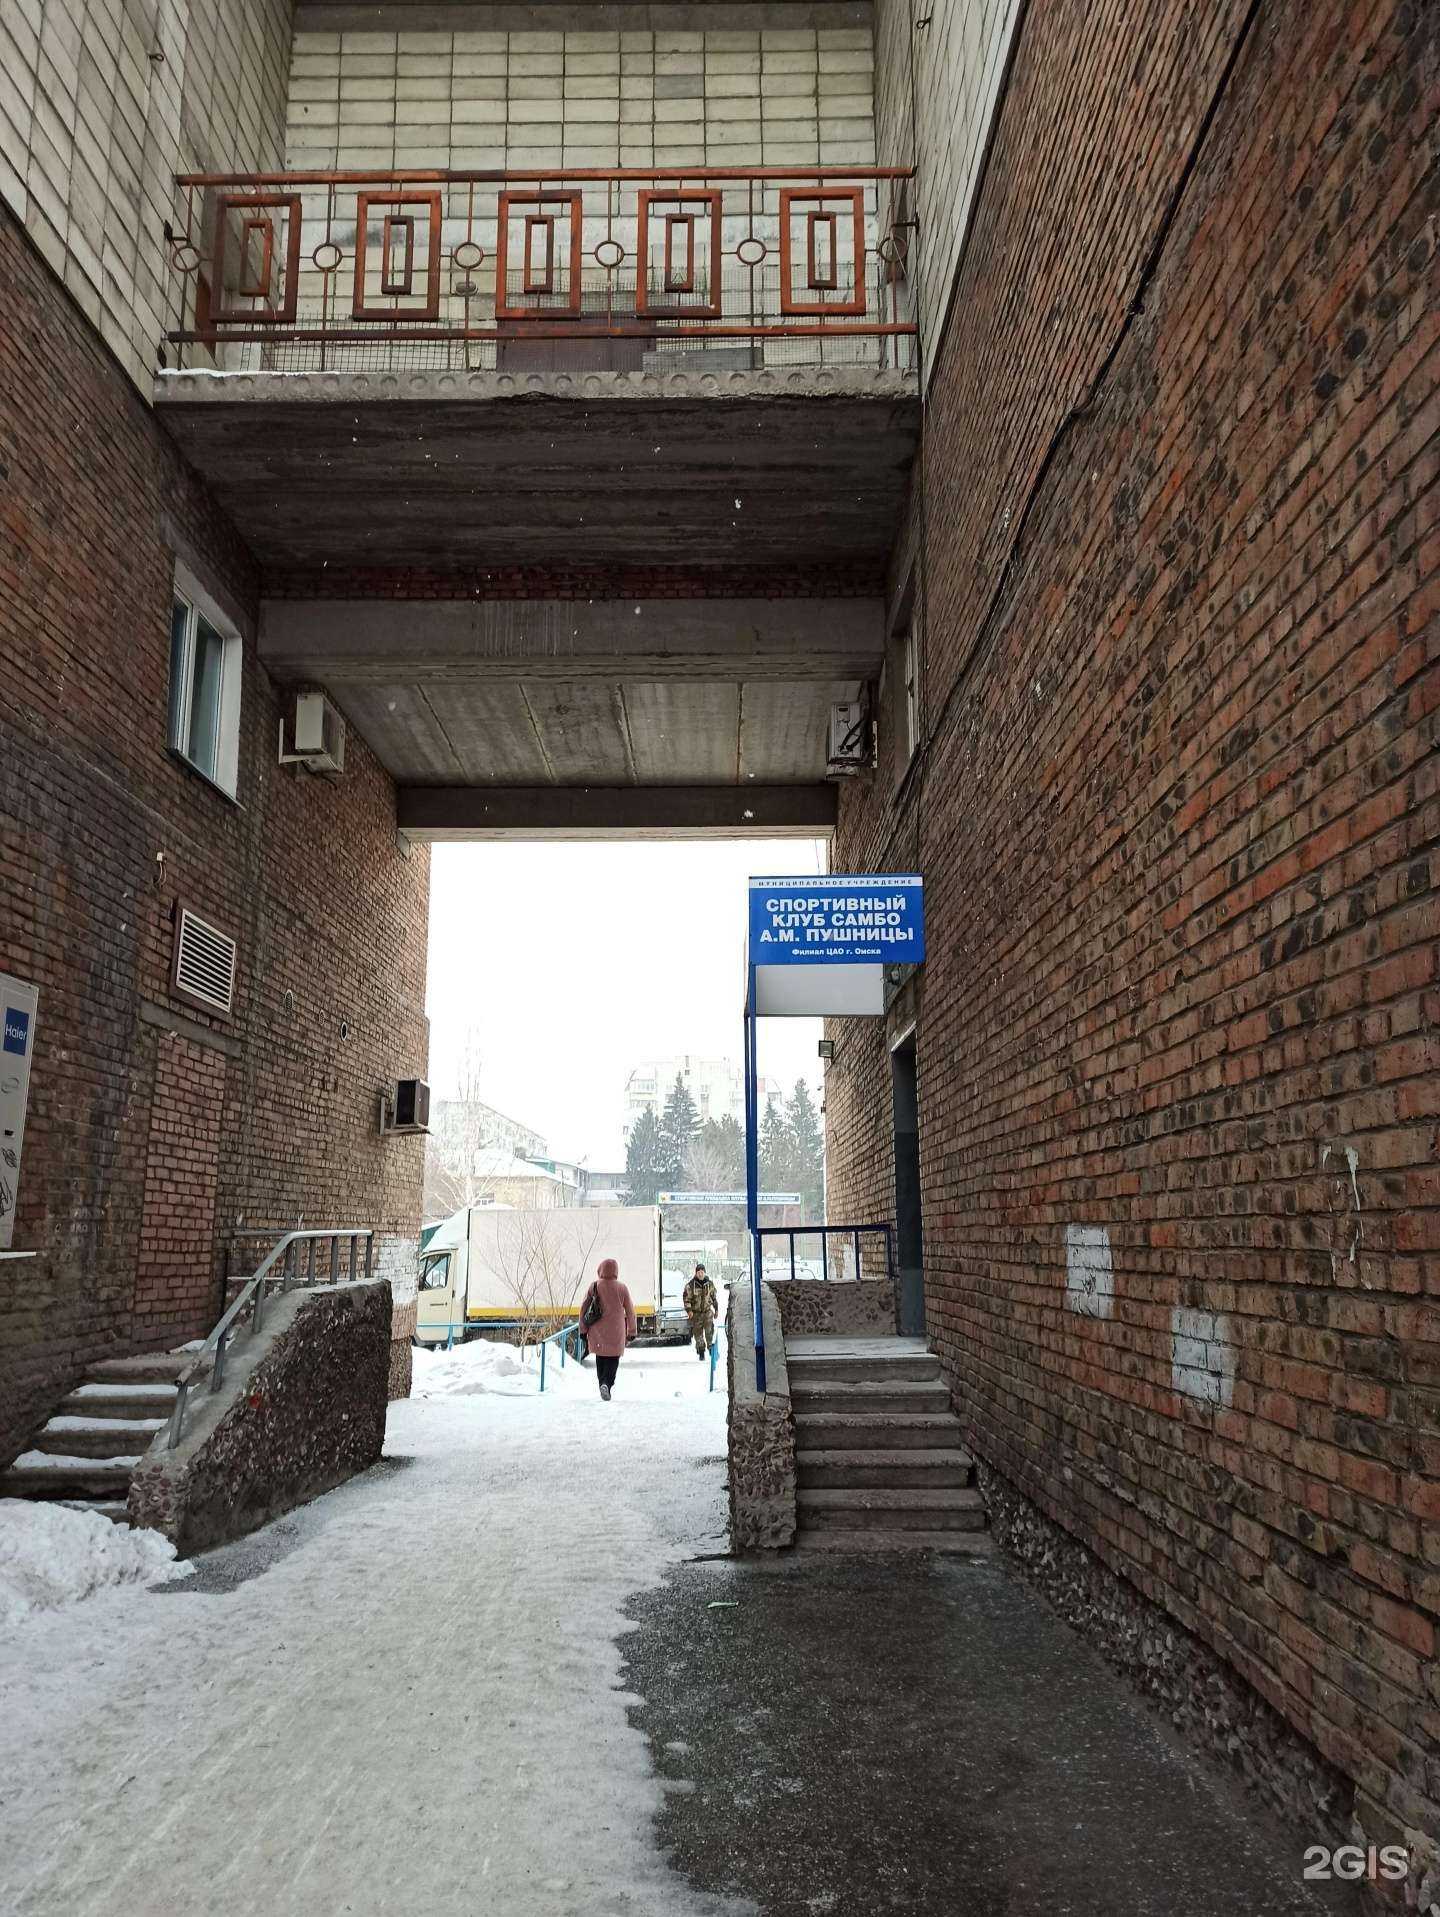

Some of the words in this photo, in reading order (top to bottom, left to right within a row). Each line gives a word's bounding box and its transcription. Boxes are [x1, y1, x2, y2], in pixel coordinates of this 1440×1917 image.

[766, 894, 906, 912] СПОРТИВНЫЙ
[772, 913, 826, 927] КЛУБ
[831, 912, 901, 926] САМБО
[760, 929, 800, 943] А.М.
[806, 927, 914, 943] ПУШНИЦЫ
[792, 948, 824, 956] Филиал
[826, 947, 845, 956] ЦАО
[854, 947, 881, 955] Омска
[5, 1023, 27, 1040] Haier
